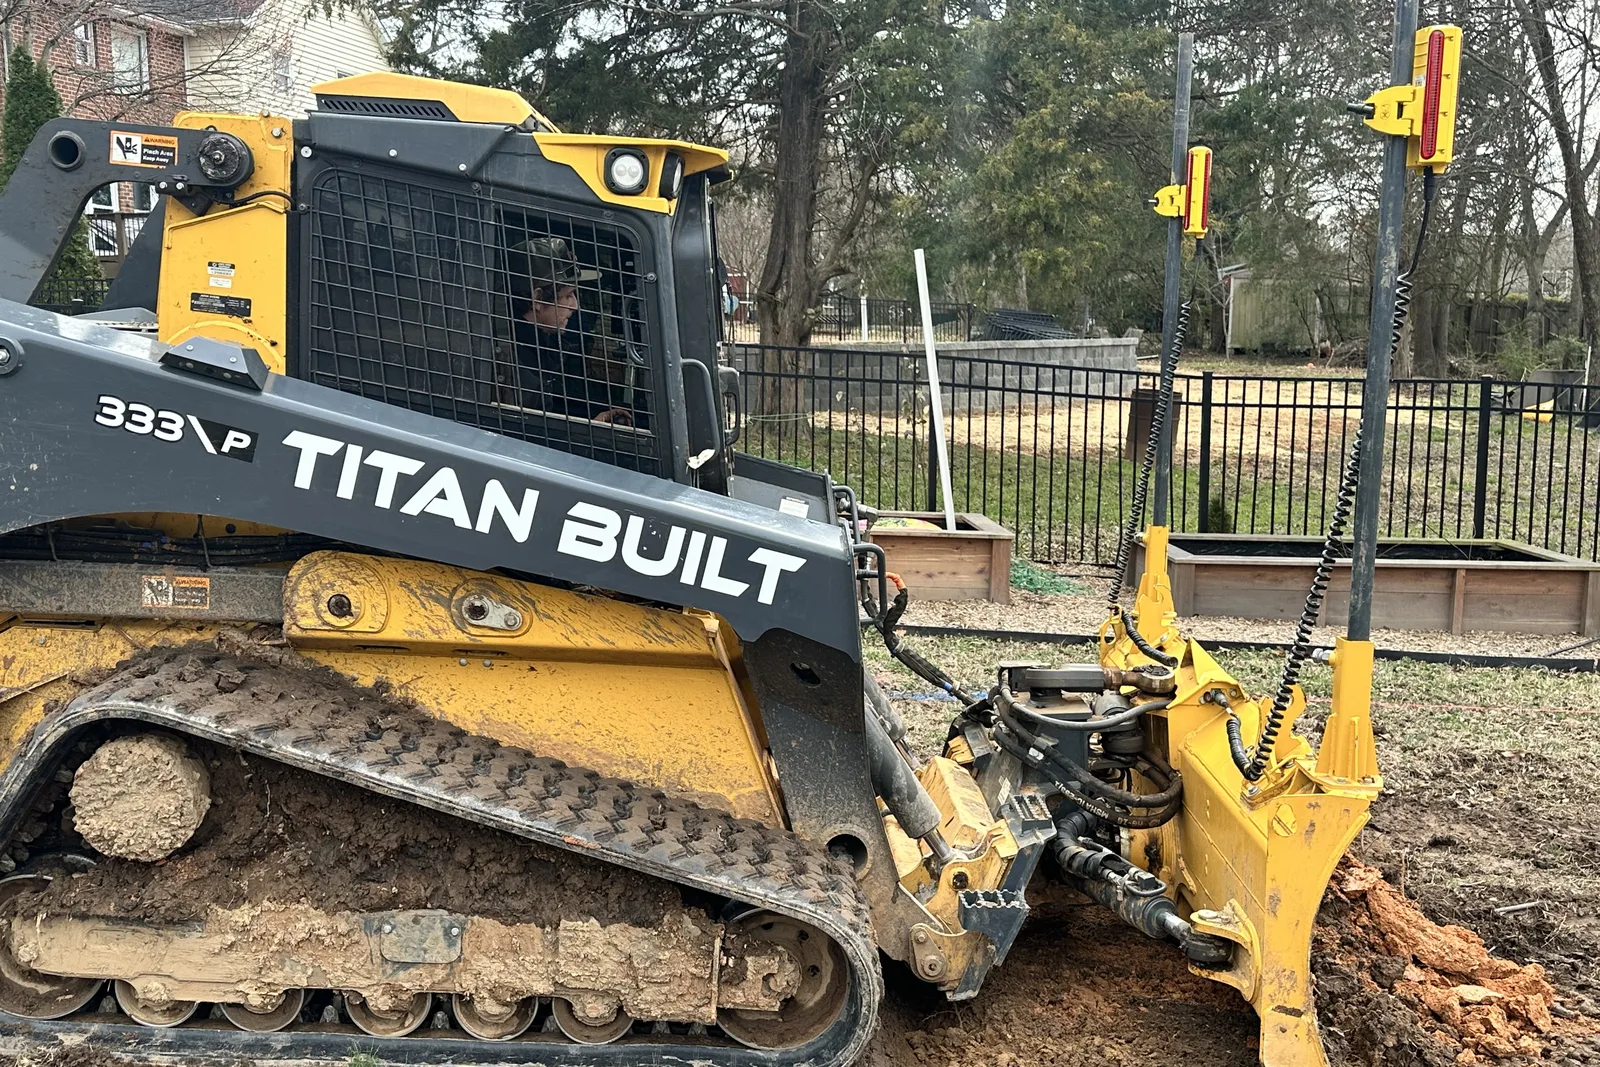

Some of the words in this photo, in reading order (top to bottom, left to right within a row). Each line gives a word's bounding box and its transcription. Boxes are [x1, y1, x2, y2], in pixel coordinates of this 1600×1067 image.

[95, 395, 185, 442] 333
[281, 429, 540, 543] TITAN
[556, 501, 807, 606] BUILT
[1085, 803, 1110, 819] MSHA
